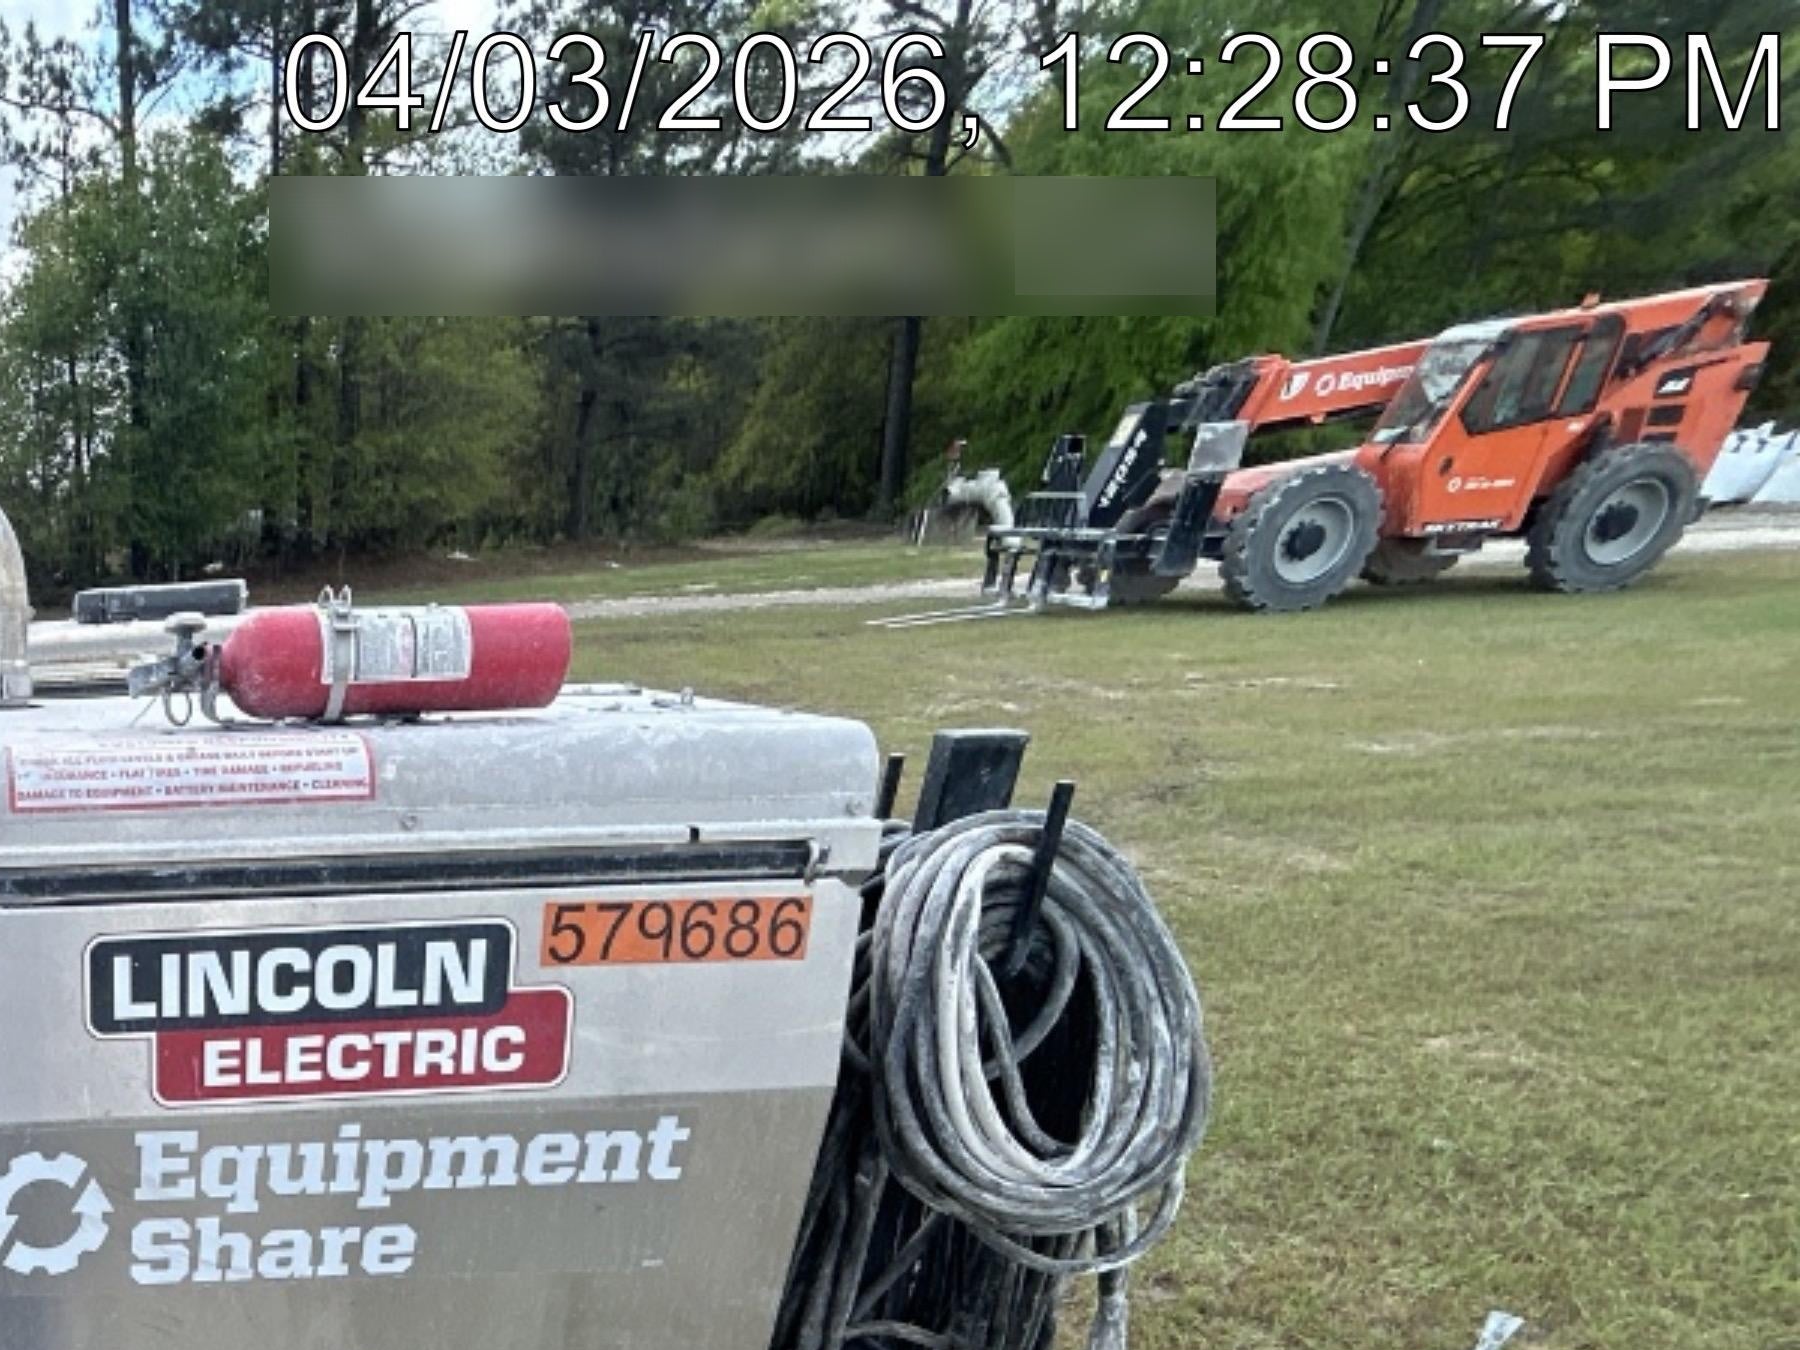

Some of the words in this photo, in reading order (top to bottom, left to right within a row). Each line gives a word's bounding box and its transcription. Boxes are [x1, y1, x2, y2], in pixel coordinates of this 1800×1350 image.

[85, 784, 153, 799] EQUIPMENT
[164, 782, 214, 796] BATTERY
[218, 779, 301, 793] MAINTENANCE
[546, 898, 806, 963] 579686
[111, 937, 488, 1022] LINCOLN
[202, 1024, 527, 1088] ELECTRIC
[132, 1114, 693, 1215] Equipment
[129, 1215, 418, 1286] Share
